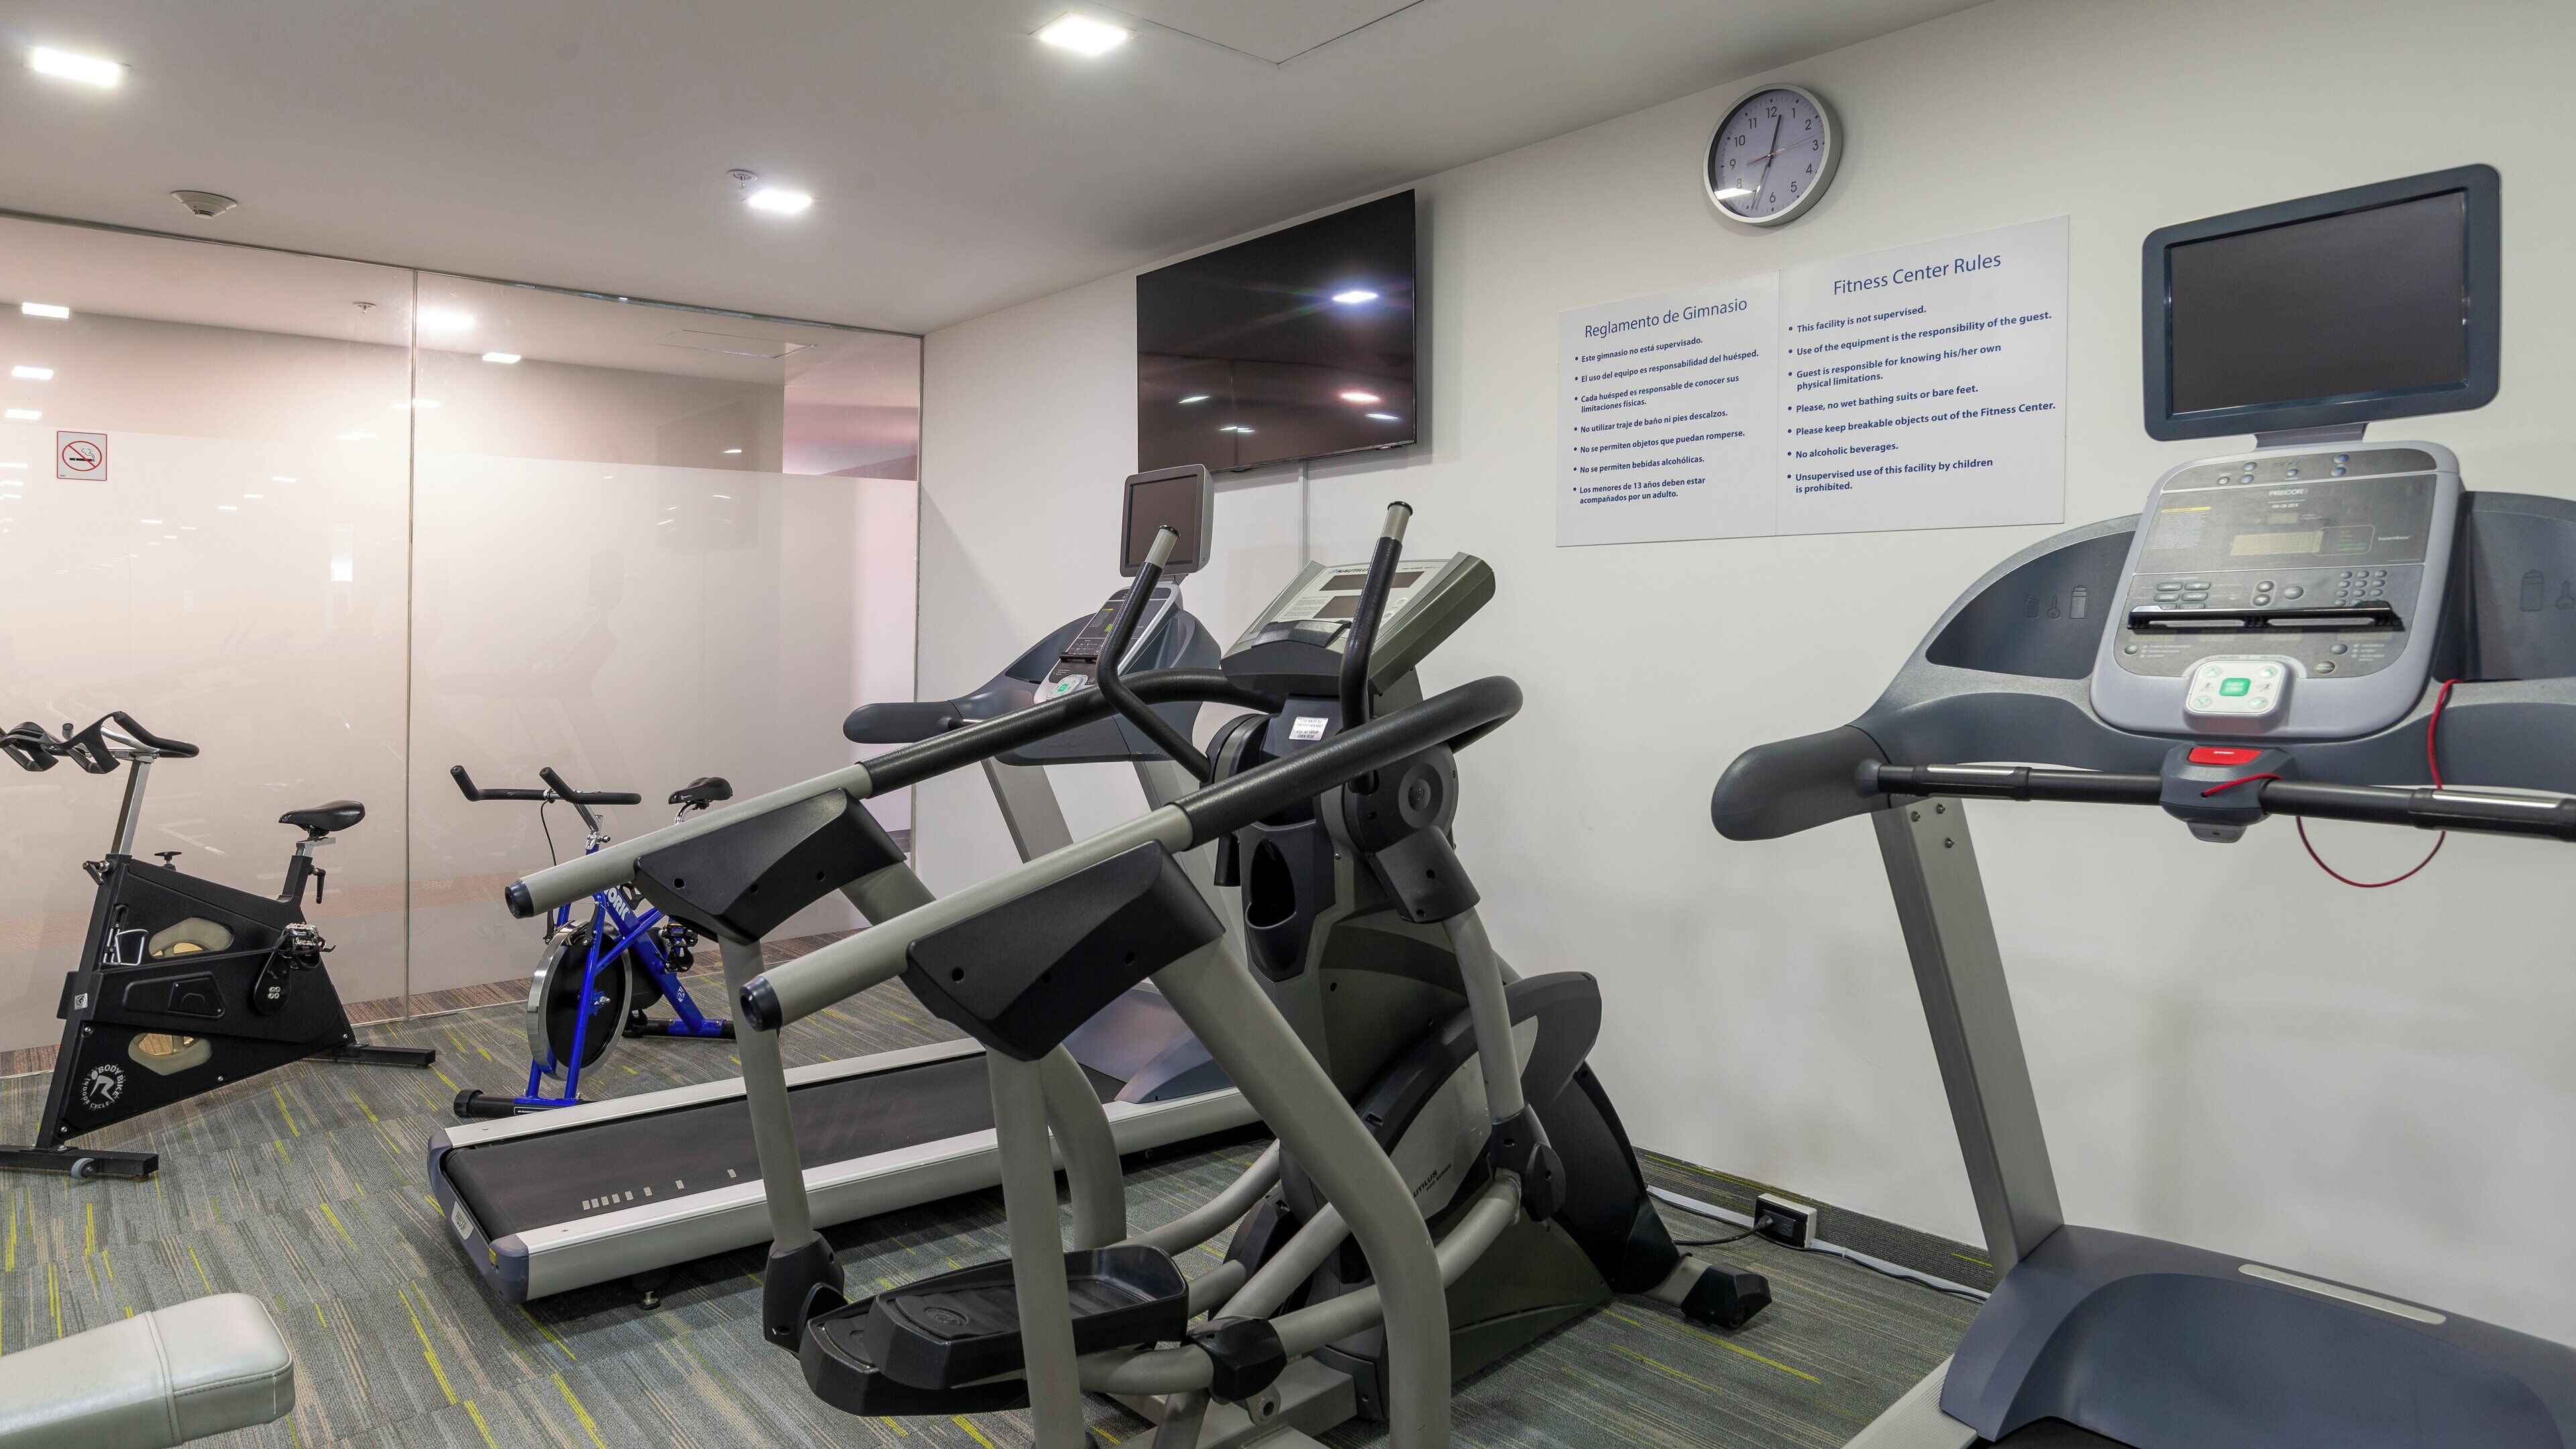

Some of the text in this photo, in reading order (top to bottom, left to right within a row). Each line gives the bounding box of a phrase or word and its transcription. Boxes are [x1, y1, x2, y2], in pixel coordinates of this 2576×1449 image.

[1766, 107, 1778, 118] 12
[1792, 108, 1796, 118] 1
[1748, 118, 1758, 129] 11
[1805, 119, 1811, 131] 2
[1734, 135, 1746, 147] 10
[1813, 140, 1819, 151] 3
[1729, 159, 1736, 170] 9
[1806, 164, 1813, 174] 4
[1737, 178, 1743, 189] 8
[1790, 181, 1797, 193] 5
[1770, 192, 1776, 203] 6
[1834, 254, 2001, 295] Fitness Center Rules
[1585, 298, 1748, 339] Reglamento de Gimnasio
[1796, 305, 1927, 333] This facility is not supervised.
[1796, 311, 2051, 356] Use of the equipment is the responsibility of the guest.
[1581, 355, 1596, 363] Este
[1597, 349, 1628, 362] gimnasio
[1640, 343, 1655, 354] está
[1656, 337, 1703, 351] supervisado.
[1581, 374, 1588, 382] El
[1602, 371, 1613, 380] del
[1614, 368, 1639, 378] equipo
[1649, 356, 1708, 373] responsabilidad
[1709, 354, 1721, 364] del
[1723, 349, 1759, 362] huésped.
[1796, 345, 2001, 378] Guest is responsible for knowing his/her own
[1580, 394, 1598, 402] Cada
[1599, 389, 1628, 400] huésped
[1638, 382, 1682, 395] responsable
[1684, 380, 1694, 388] de
[1695, 378, 1725, 387] conocer
[1796, 374, 1883, 392] physical limitations.
[1581, 399, 1647, 413] limitaciones físicas.
[1796, 404, 1825, 413] Please,
[1840, 399, 1857, 408] wet
[1858, 395, 1894, 406] bathing
[1896, 392, 1918, 402] suits
[1932, 388, 1954, 397] bare
[1955, 385, 1978, 394] feet.
[1591, 423, 1615, 432] utilizar
[1616, 421, 1633, 430] traje
[1633, 419, 1643, 427] de
[1644, 417, 1663, 426] baño
[1664, 415, 1671, 423] ni
[1672, 414, 1688, 425] pies
[1689, 410, 1728, 421] descalzos.
[1796, 402, 2055, 436] Please keep breakable objects out of the Fitness Center.
[1599, 442, 1631, 453] permiten
[1632, 439, 1659, 449] objetos
[1660, 438, 1674, 447] que
[1676, 433, 1705, 445] puedan
[1706, 431, 1746, 441] romperse.
[1796, 443, 1898, 459] No alcoholic beverages.
[1599, 463, 1631, 474] permiten
[1632, 459, 1660, 468] bebidas
[1661, 455, 1705, 466] alcohólicas.
[1795, 468, 1855, 482] Unsupervised
[1874, 466, 1884, 476] of
[1884, 465, 1902, 474] this
[1904, 463, 1937, 473] facility
[1938, 462, 1951, 472] by
[1952, 458, 1993, 469] children
[1592, 484, 1622, 493] menores
[1623, 482, 1632, 490] de
[1643, 480, 1660, 488] años
[1662, 478, 1685, 487] deben
[1796, 481, 1853, 494] is prohibited.
[1580, 494, 1627, 504] acompañados
[1628, 494, 1641, 502] por
[1652, 490, 1678, 499] adulto.
[98, 1064, 123, 1097] BODY BIKE
[82, 1077, 110, 1110] INDOOR CYCLE
[1413, 1170, 1438, 1198] UTILUS
